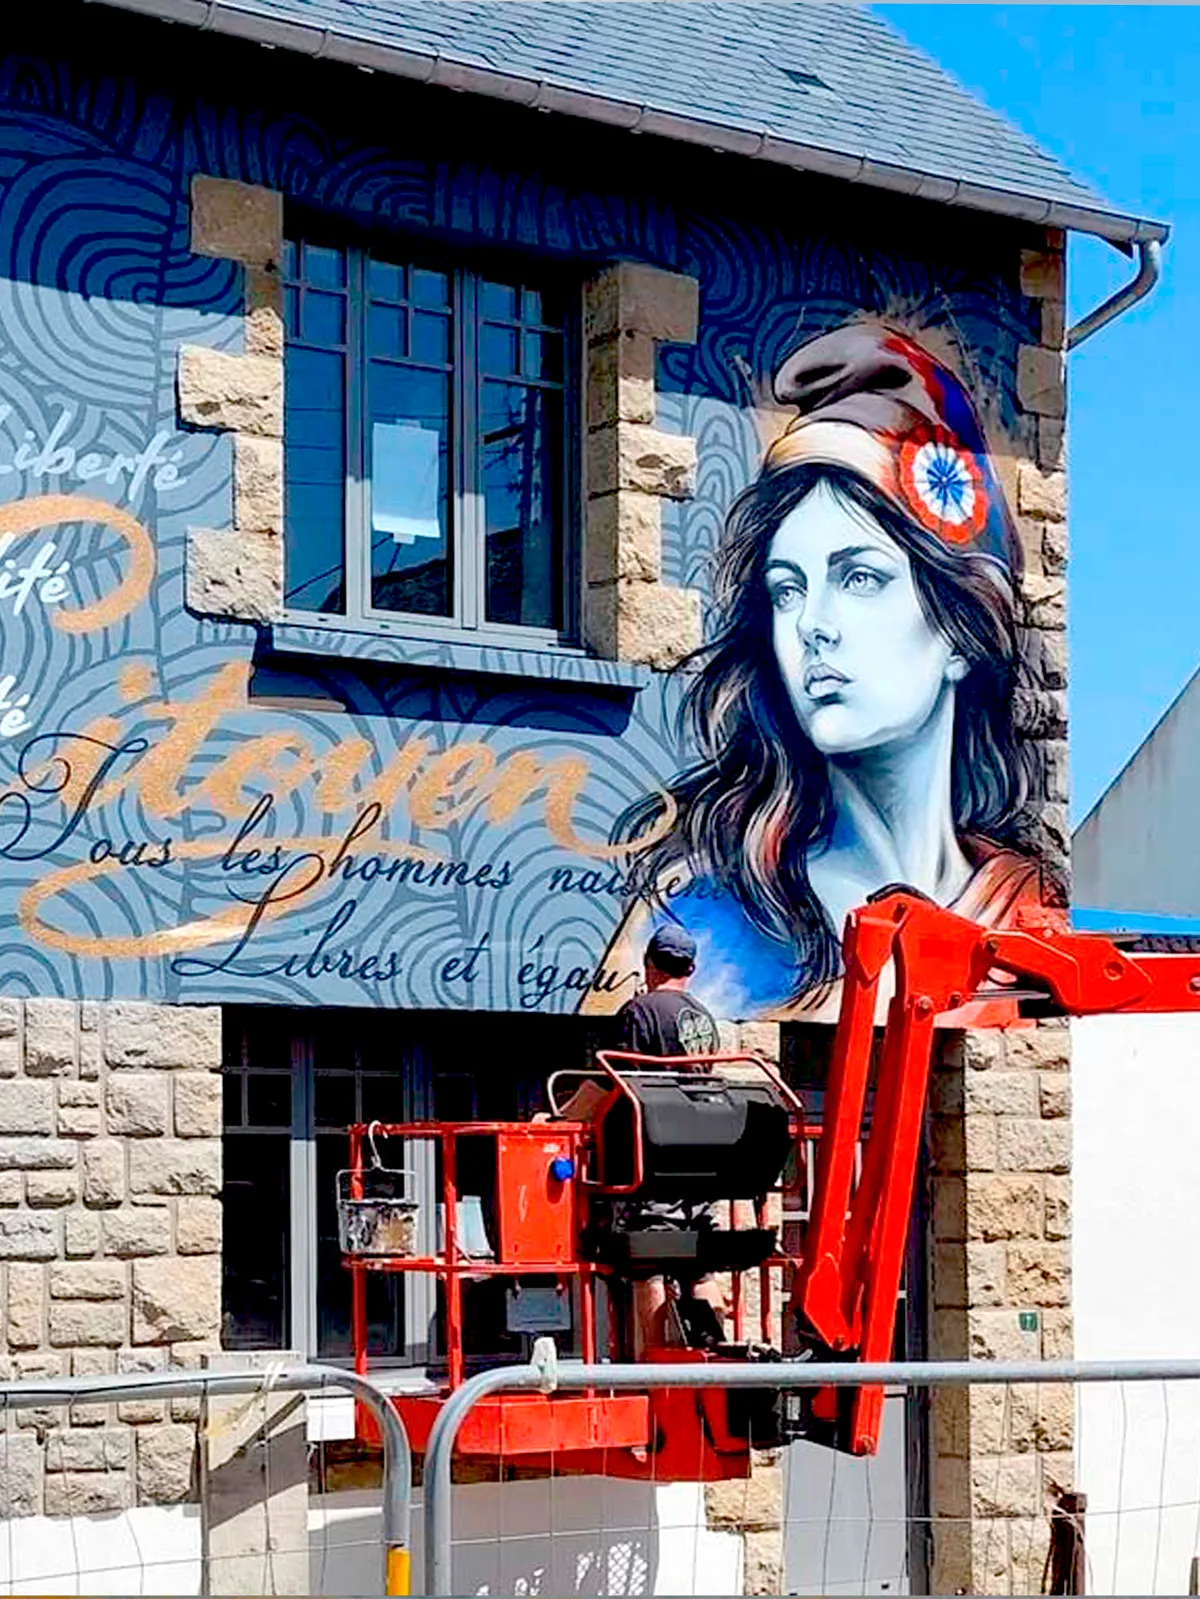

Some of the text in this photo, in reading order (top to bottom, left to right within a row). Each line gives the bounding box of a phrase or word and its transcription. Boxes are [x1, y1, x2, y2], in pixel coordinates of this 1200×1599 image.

[221, 793, 288, 875] les
[329, 801, 515, 889] hommes
[170, 853, 402, 981] Libres
[441, 931, 491, 982] et
